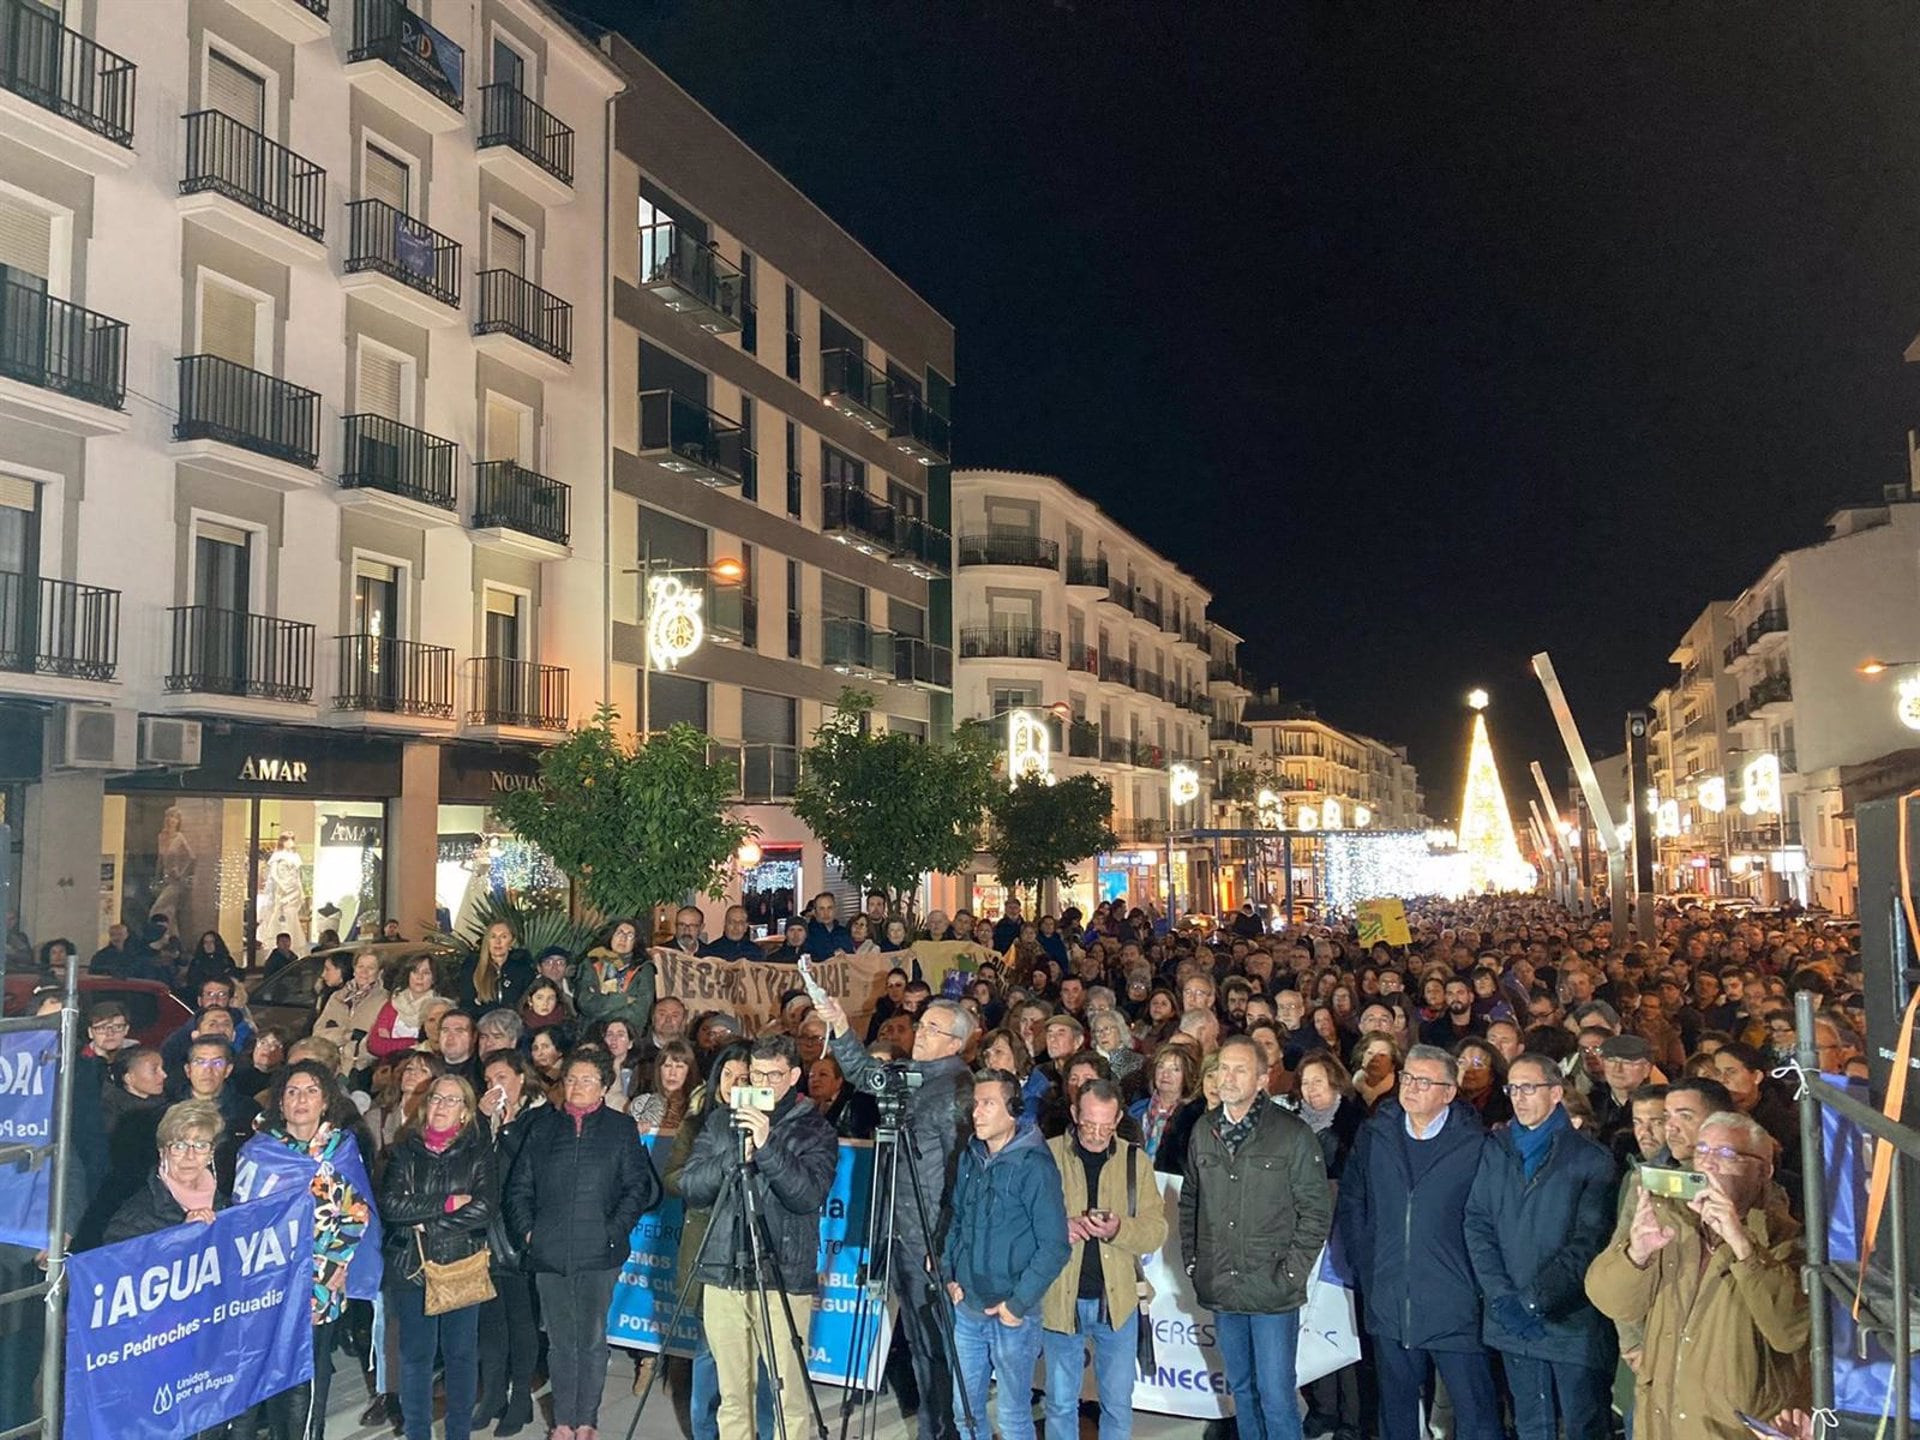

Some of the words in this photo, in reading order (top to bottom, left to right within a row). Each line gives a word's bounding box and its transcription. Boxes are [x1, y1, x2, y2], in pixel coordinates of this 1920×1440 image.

[237, 755, 307, 782] AMAR
[490, 770, 546, 792] NOVIAS
[90, 1246, 222, 1329] ¡AGUA
[234, 1220, 299, 1277] YA!
[86, 1350, 119, 1371] Los
[122, 1317, 200, 1361] Pedroches
[212, 1303, 226, 1325] El
[175, 1386, 192, 1402] por
[194, 1383, 204, 1394] el
[205, 1373, 234, 1396] Agua
[177, 1370, 210, 1390] Unidos
